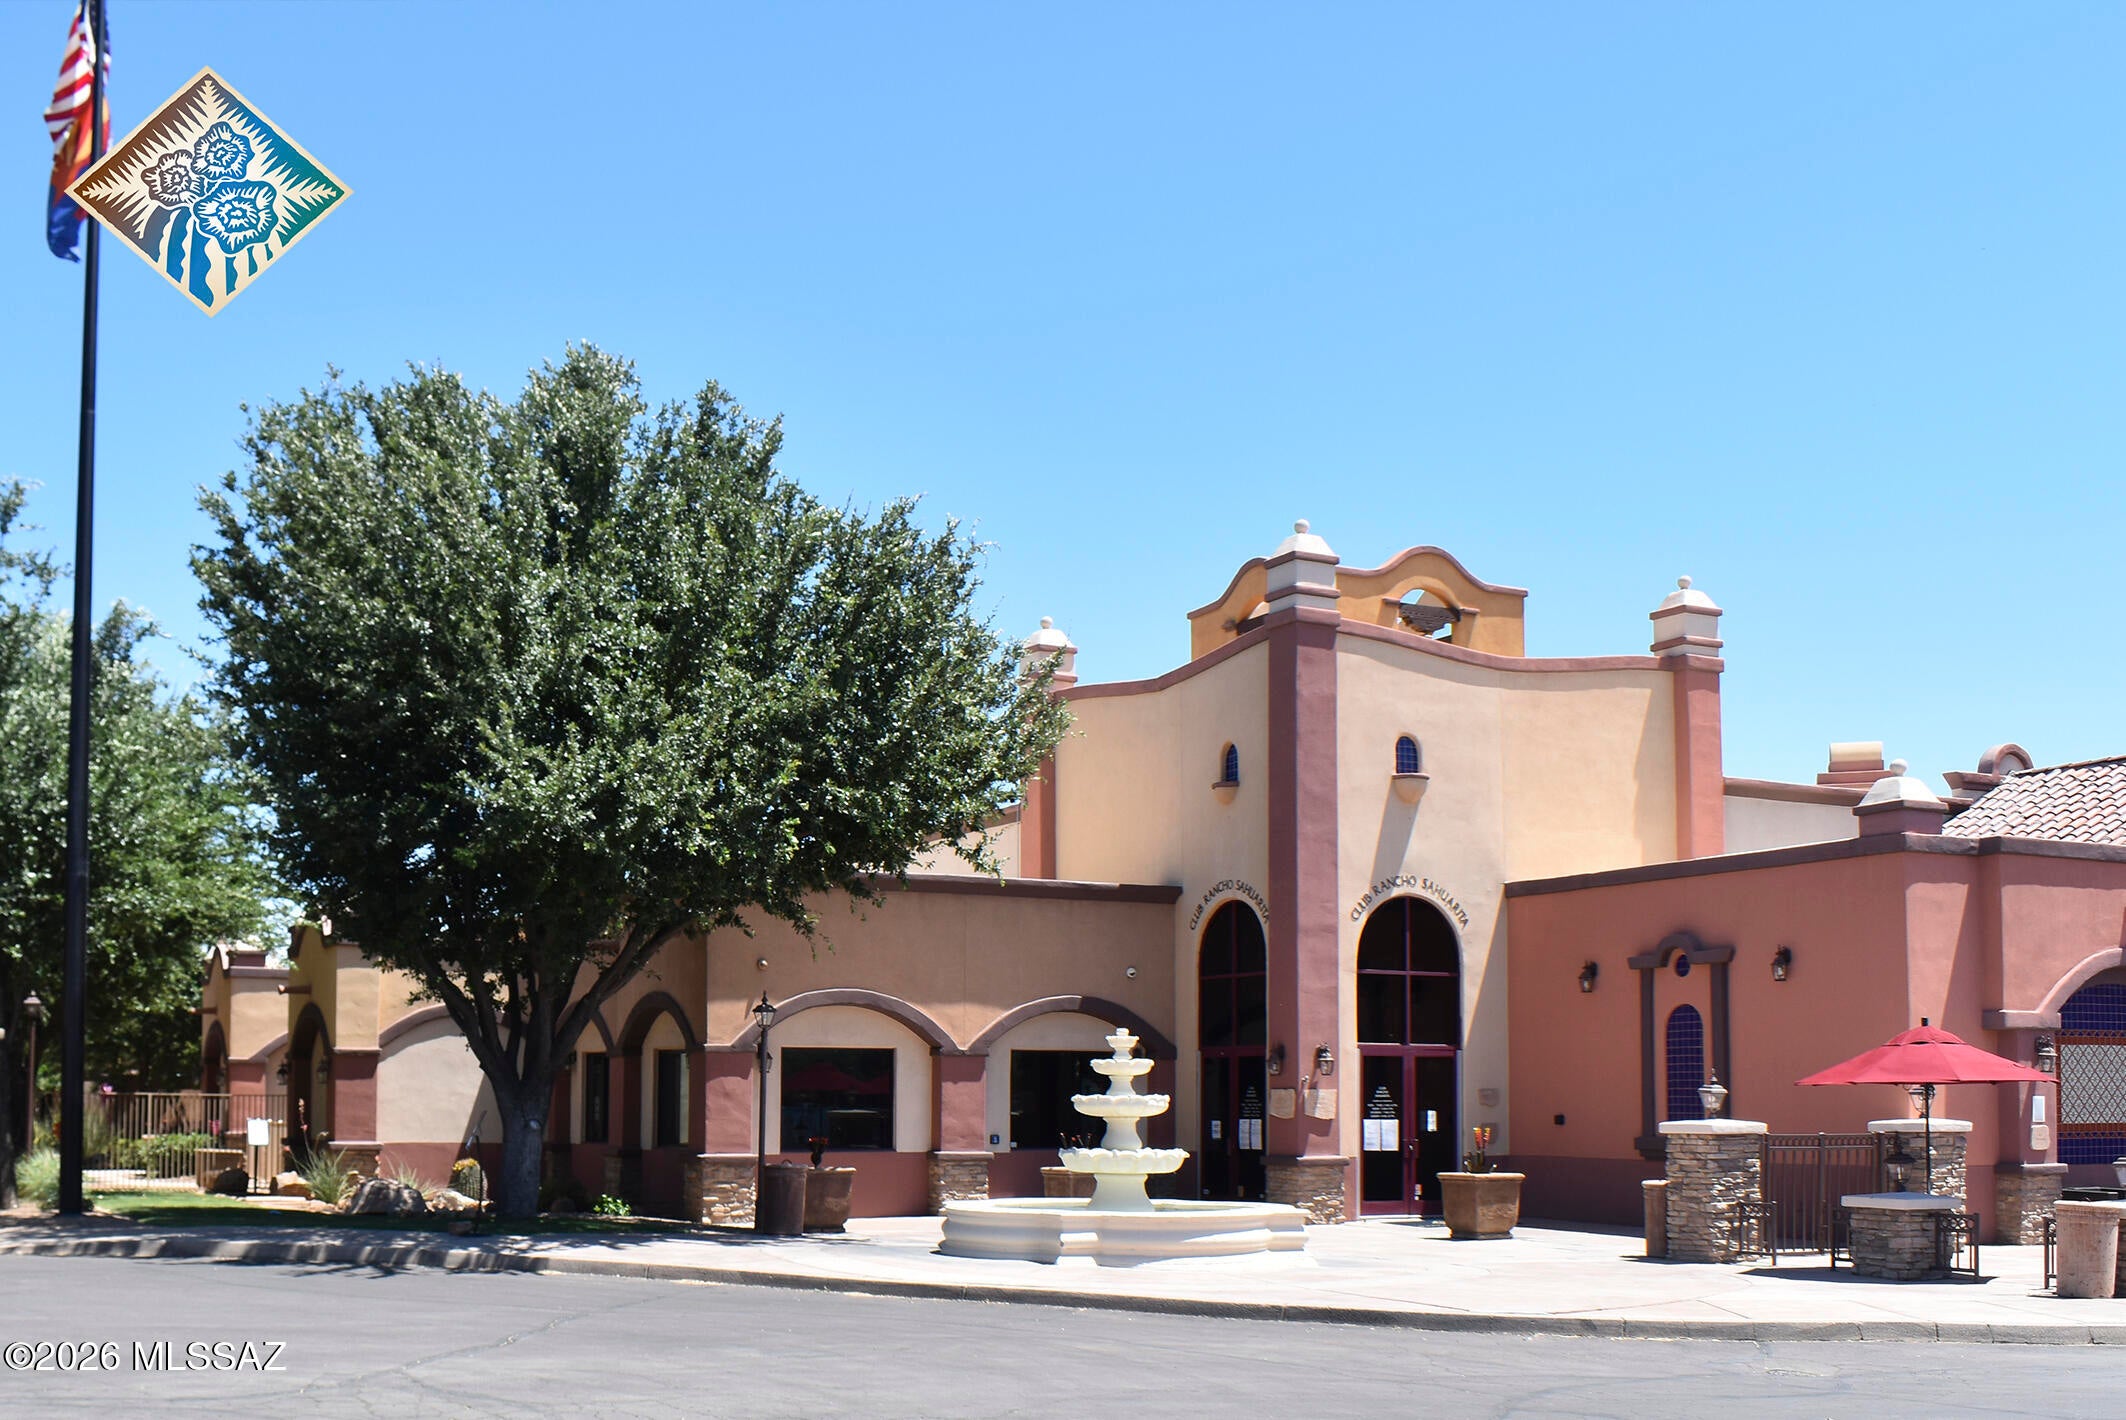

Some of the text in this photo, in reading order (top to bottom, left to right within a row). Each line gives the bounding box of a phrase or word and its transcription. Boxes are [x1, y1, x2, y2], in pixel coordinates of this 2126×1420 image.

[1190, 903, 1204, 930] CLUB
[1202, 879, 1234, 905] RANCHO
[1350, 875, 1469, 929] CLUB RANCHO SAHUARITA
